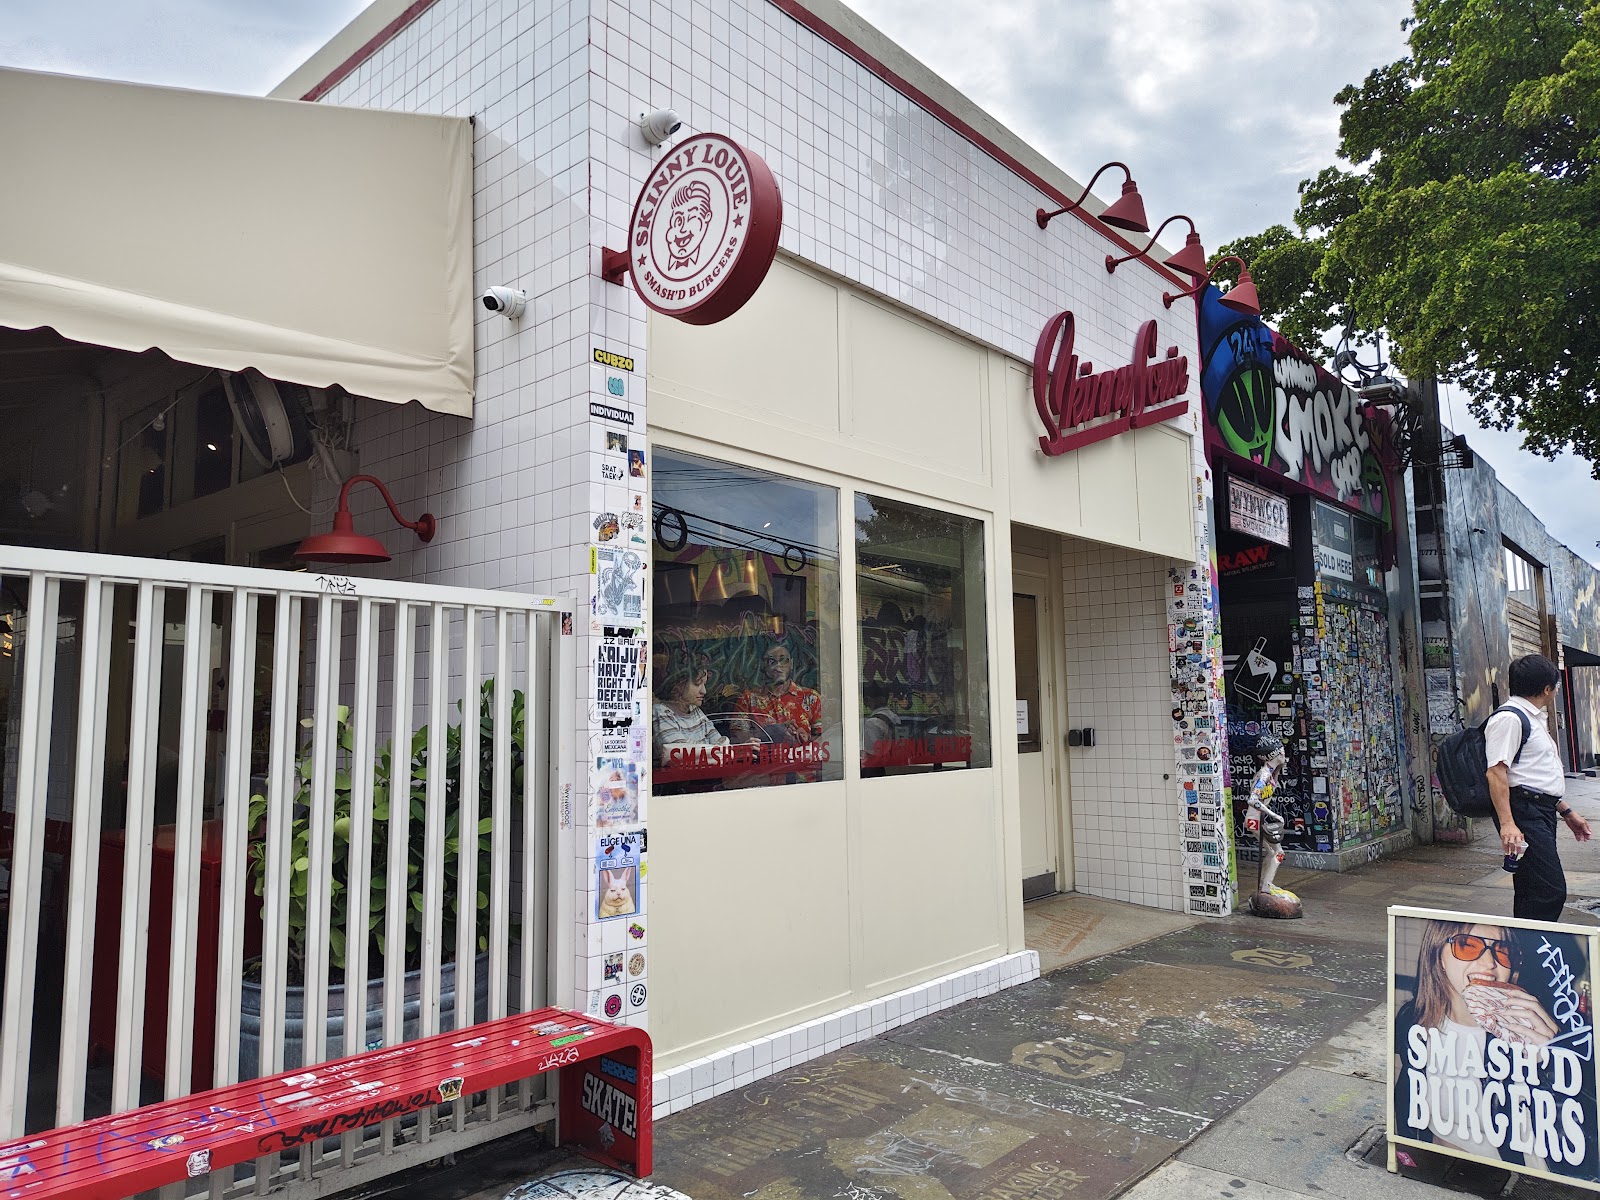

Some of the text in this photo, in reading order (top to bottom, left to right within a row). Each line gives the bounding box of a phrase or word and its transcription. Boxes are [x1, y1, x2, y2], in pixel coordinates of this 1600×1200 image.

[636, 144, 747, 246] SKINNY LOUIE
[644, 236, 738, 300] SMASH'D BURGERS
[594, 350, 633, 370] CUBZO
[1033, 310, 1134, 457] Skinny
[591, 404, 633, 423] INDIVIDUAL
[1275, 384, 1369, 481] SMOKE
[1217, 544, 1270, 571] RAW
[1320, 551, 1352, 575] SOLD HERE
[598, 645, 639, 663] KAIJU
[597, 663, 626, 677] HAVE
[597, 677, 623, 688] RIGHT
[597, 688, 633, 702] DEFEN
[597, 702, 631, 710] THEMSELVE
[1228, 720, 1295, 736] MOKES
[760, 741, 831, 765] BURGERS
[1229, 766, 1256, 774] OPEN
[1249, 820, 1257, 830] 2
[621, 836, 636, 845] UNA
[1023, 1041, 1112, 1076] 24
[1408, 1025, 1582, 1097] SMASH'D
[582, 1072, 637, 1139] SKATE!
[1408, 1068, 1586, 1167] BURGERS
